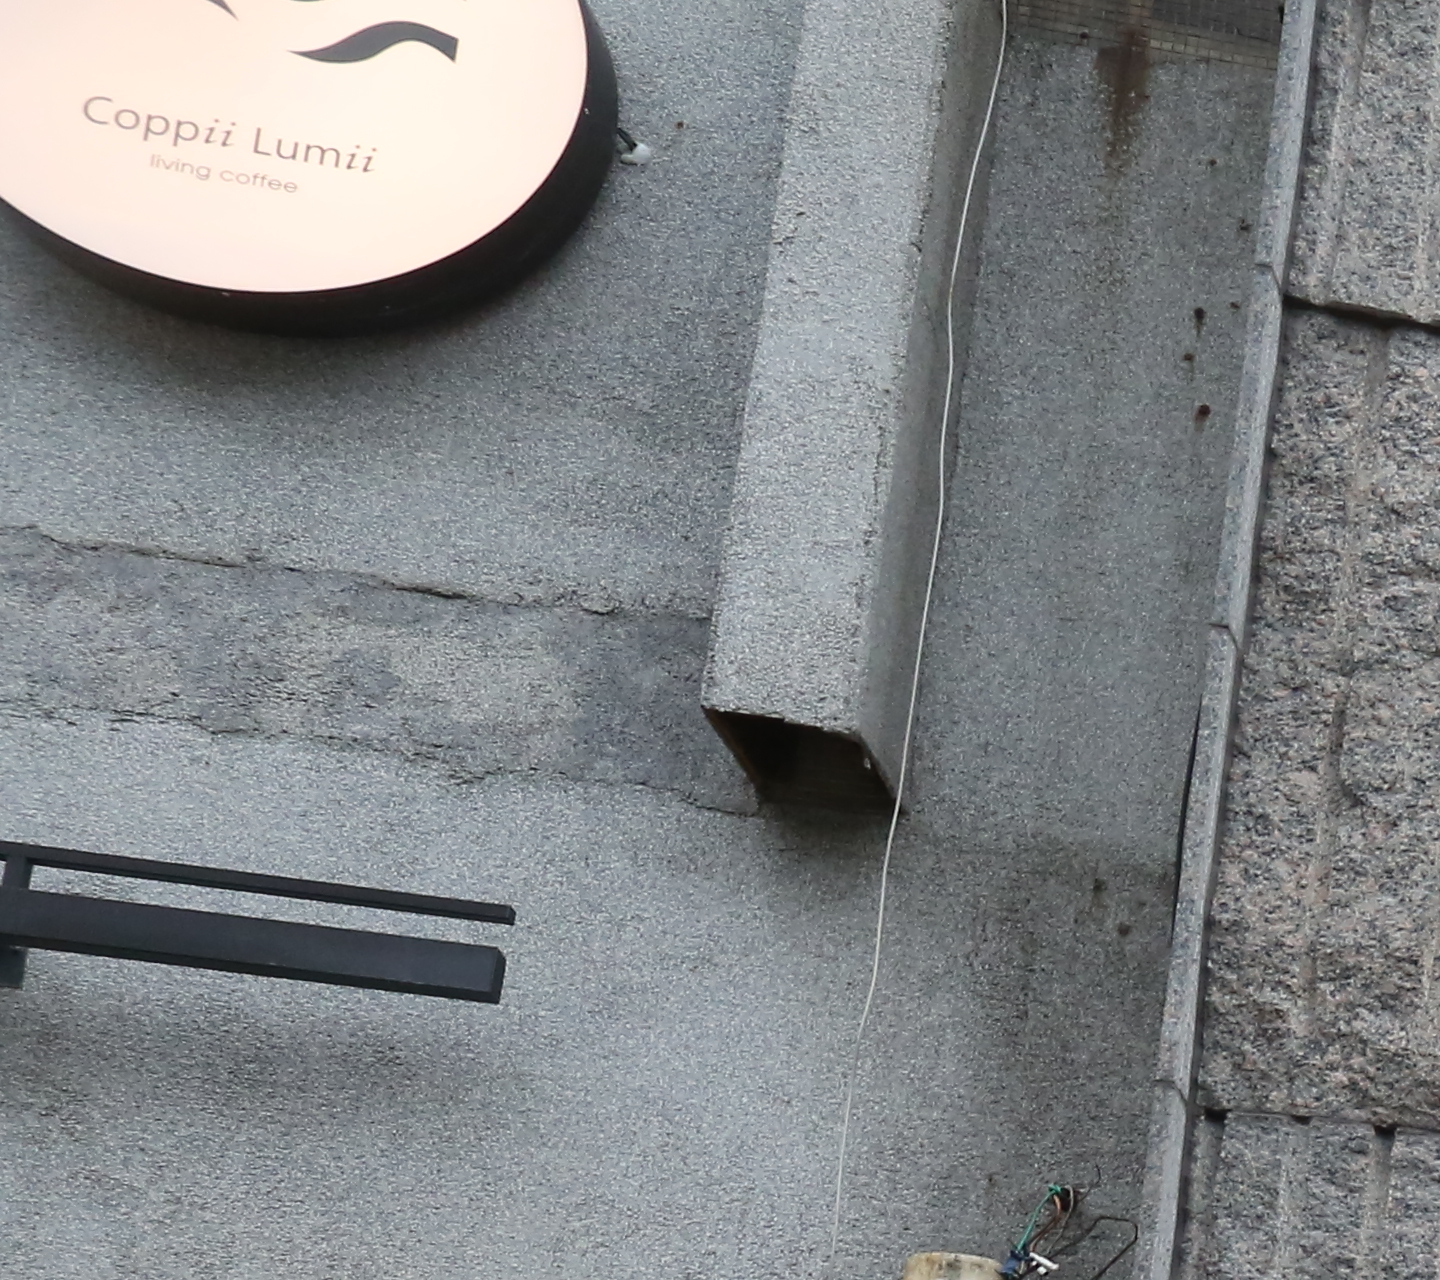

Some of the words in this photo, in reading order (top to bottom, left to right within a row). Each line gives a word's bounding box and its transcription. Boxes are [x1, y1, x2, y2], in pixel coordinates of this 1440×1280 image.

[82, 94, 236, 149] Coppii
[251, 126, 378, 175] Lumii
[149, 154, 211, 182] living
[219, 170, 299, 194] coffee
